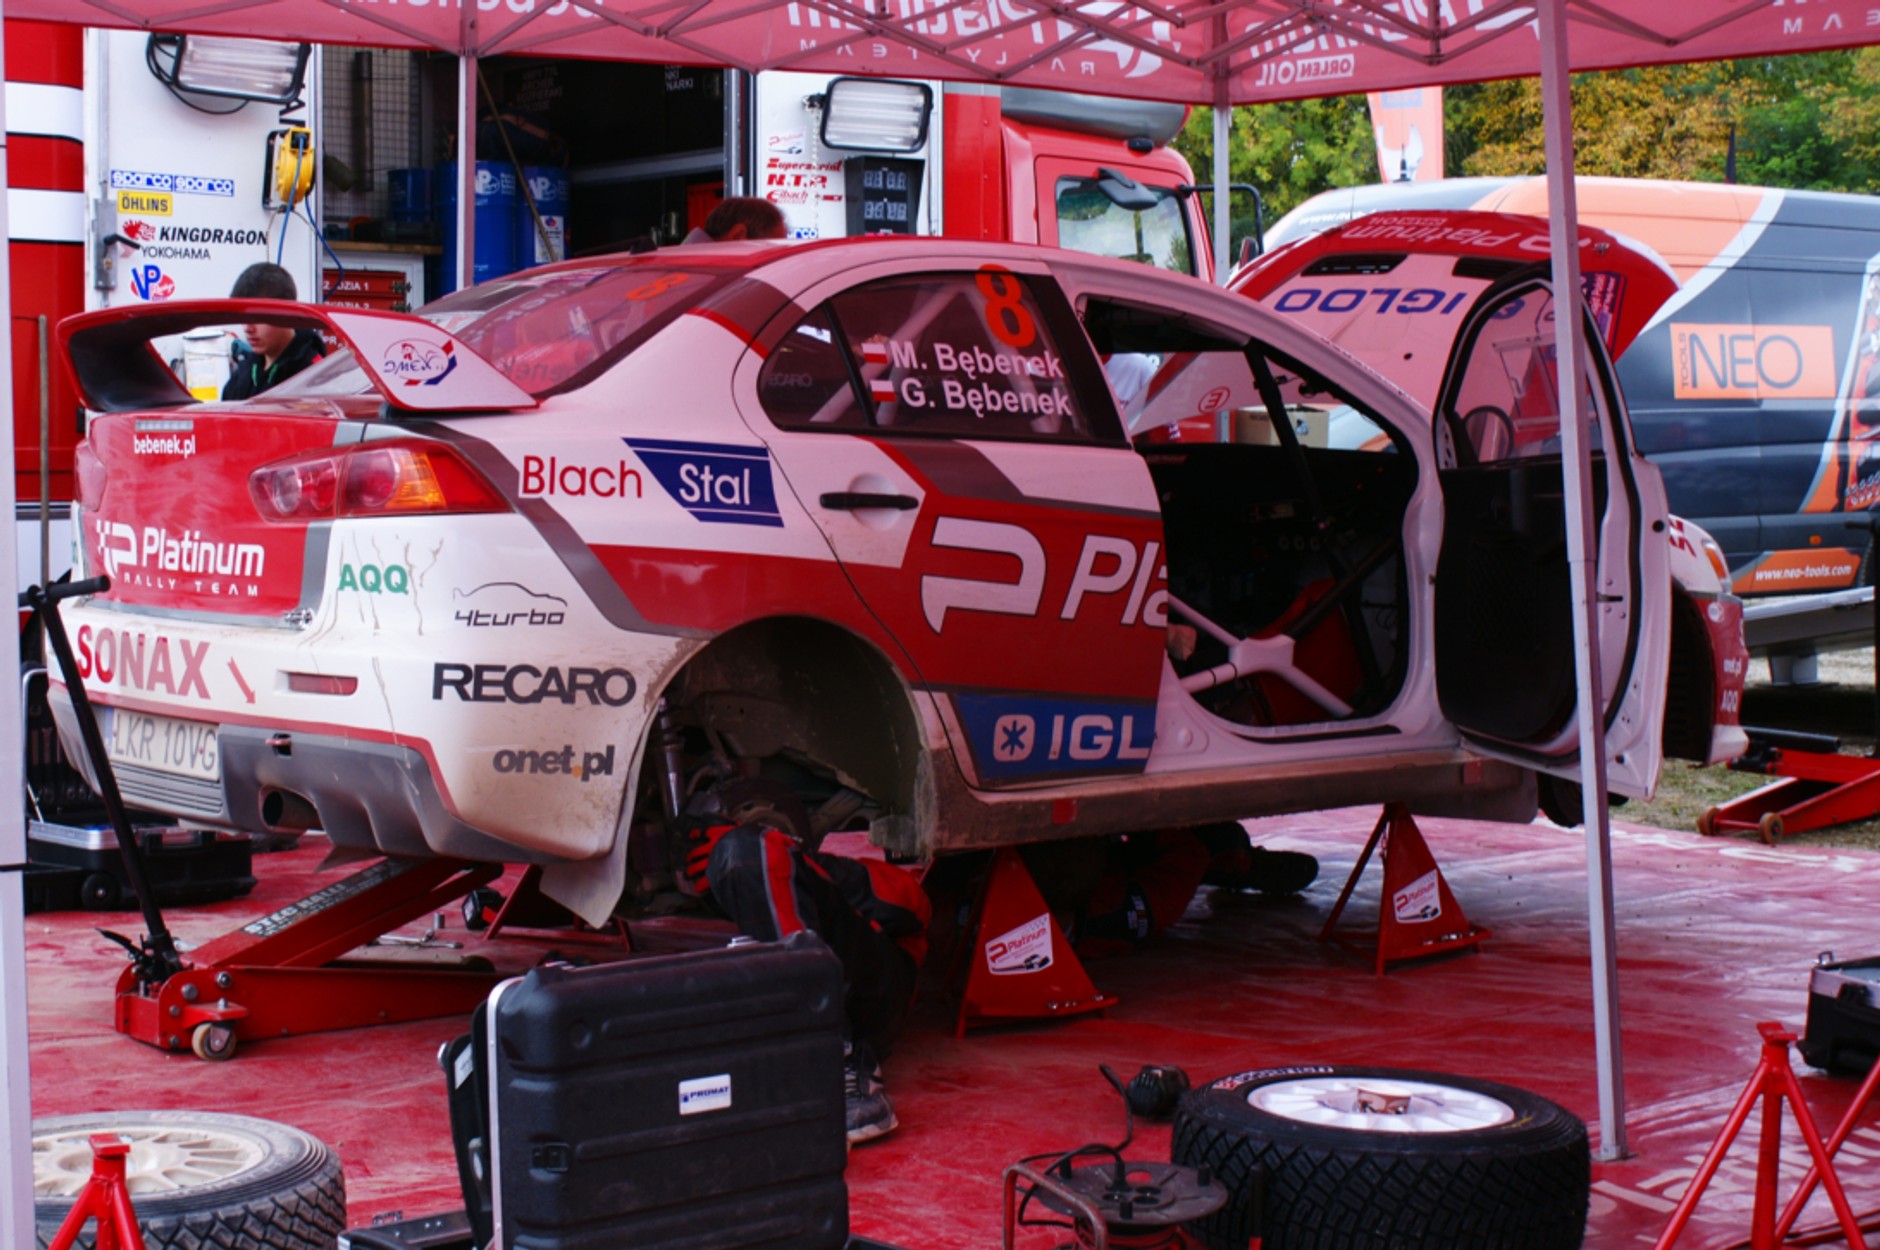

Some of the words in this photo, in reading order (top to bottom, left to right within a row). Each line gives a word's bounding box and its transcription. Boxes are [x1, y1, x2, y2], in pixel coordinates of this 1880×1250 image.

[112, 171, 172, 190] sparco
[175, 177, 232, 195] sparco
[122, 193, 168, 212] ÖHLINS
[159, 226, 268, 246] KINGDRAGON
[1342, 225, 1521, 247] Platinum
[141, 245, 211, 260] YOKOHAMA
[131, 265, 161, 300] VP
[363, 282, 370, 291] 1
[975, 263, 1036, 348] 8
[1275, 288, 1467, 315] IGLOO
[889, 339, 928, 370] M.
[933, 342, 1064, 380] Bębenek
[1678, 332, 1688, 389] TOOLS
[1688, 332, 1804, 390] NEO
[900, 377, 935, 408] G.
[941, 379, 1073, 418] Bębenek
[133, 435, 196, 458] bebenek.pl
[522, 455, 643, 498] Blach
[679, 463, 750, 505] Stal
[141, 527, 265, 577] Platinum
[124, 572, 176, 591] RALLY
[195, 580, 258, 597] TEAM
[338, 563, 409, 595] AQQ
[1754, 563, 1852, 583] www.neo-tools.com
[454, 609, 565, 627] 4turbo
[76, 624, 211, 699] SONAX
[432, 662, 637, 707] RECARO
[115, 712, 156, 760] LKR
[162, 719, 217, 771] 10VG
[492, 744, 616, 782] onet.pl
[1007, 928, 1047, 951] Platinum
[690, 1086, 729, 1098] PROMAT
